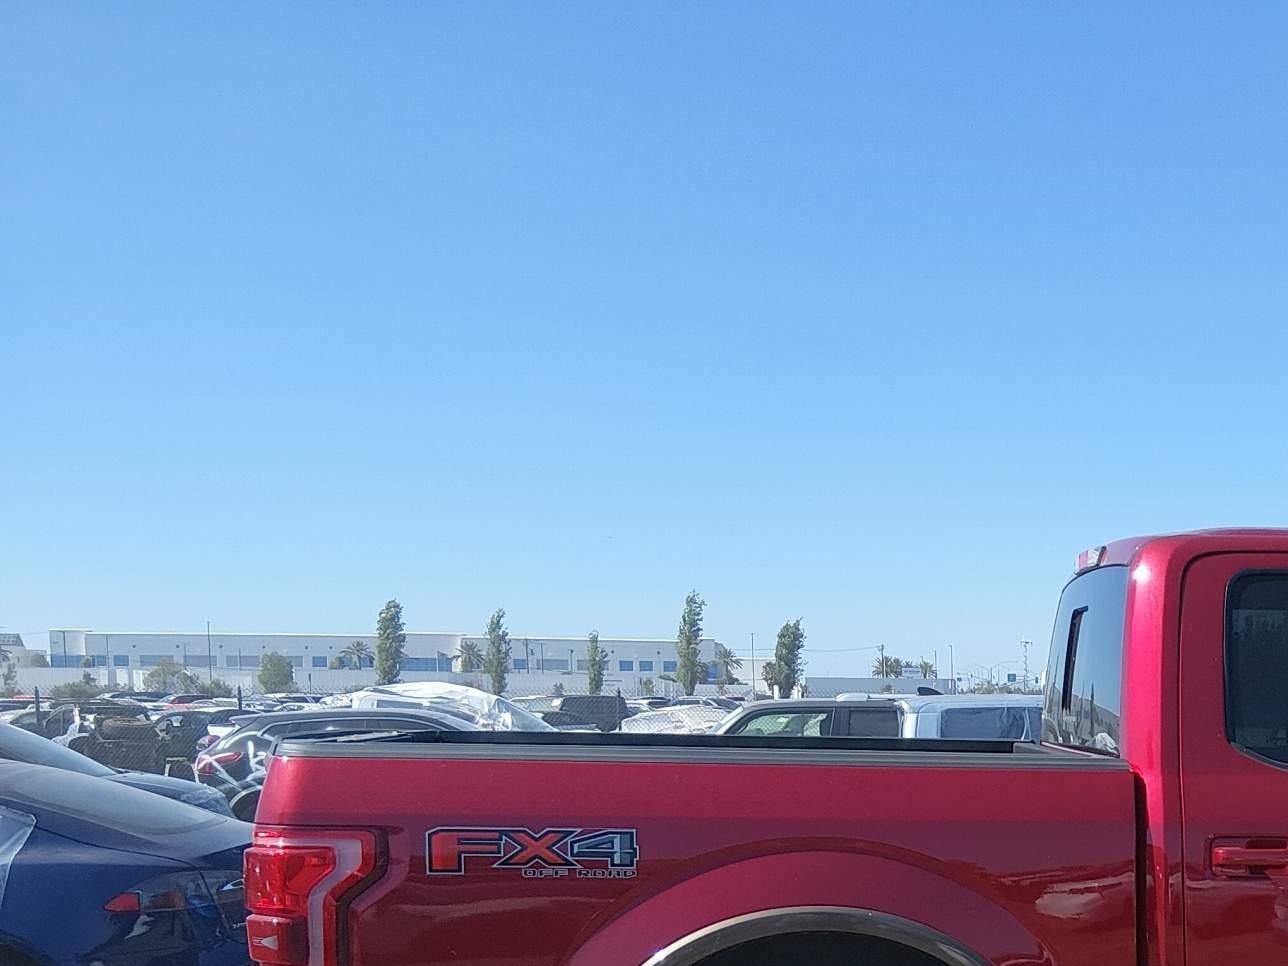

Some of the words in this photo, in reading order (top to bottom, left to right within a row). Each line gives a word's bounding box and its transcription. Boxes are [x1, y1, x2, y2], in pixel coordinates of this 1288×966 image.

[426, 826, 640, 876] FX4
[521, 868, 569, 879] OFF
[576, 868, 638, 880] ROAD
